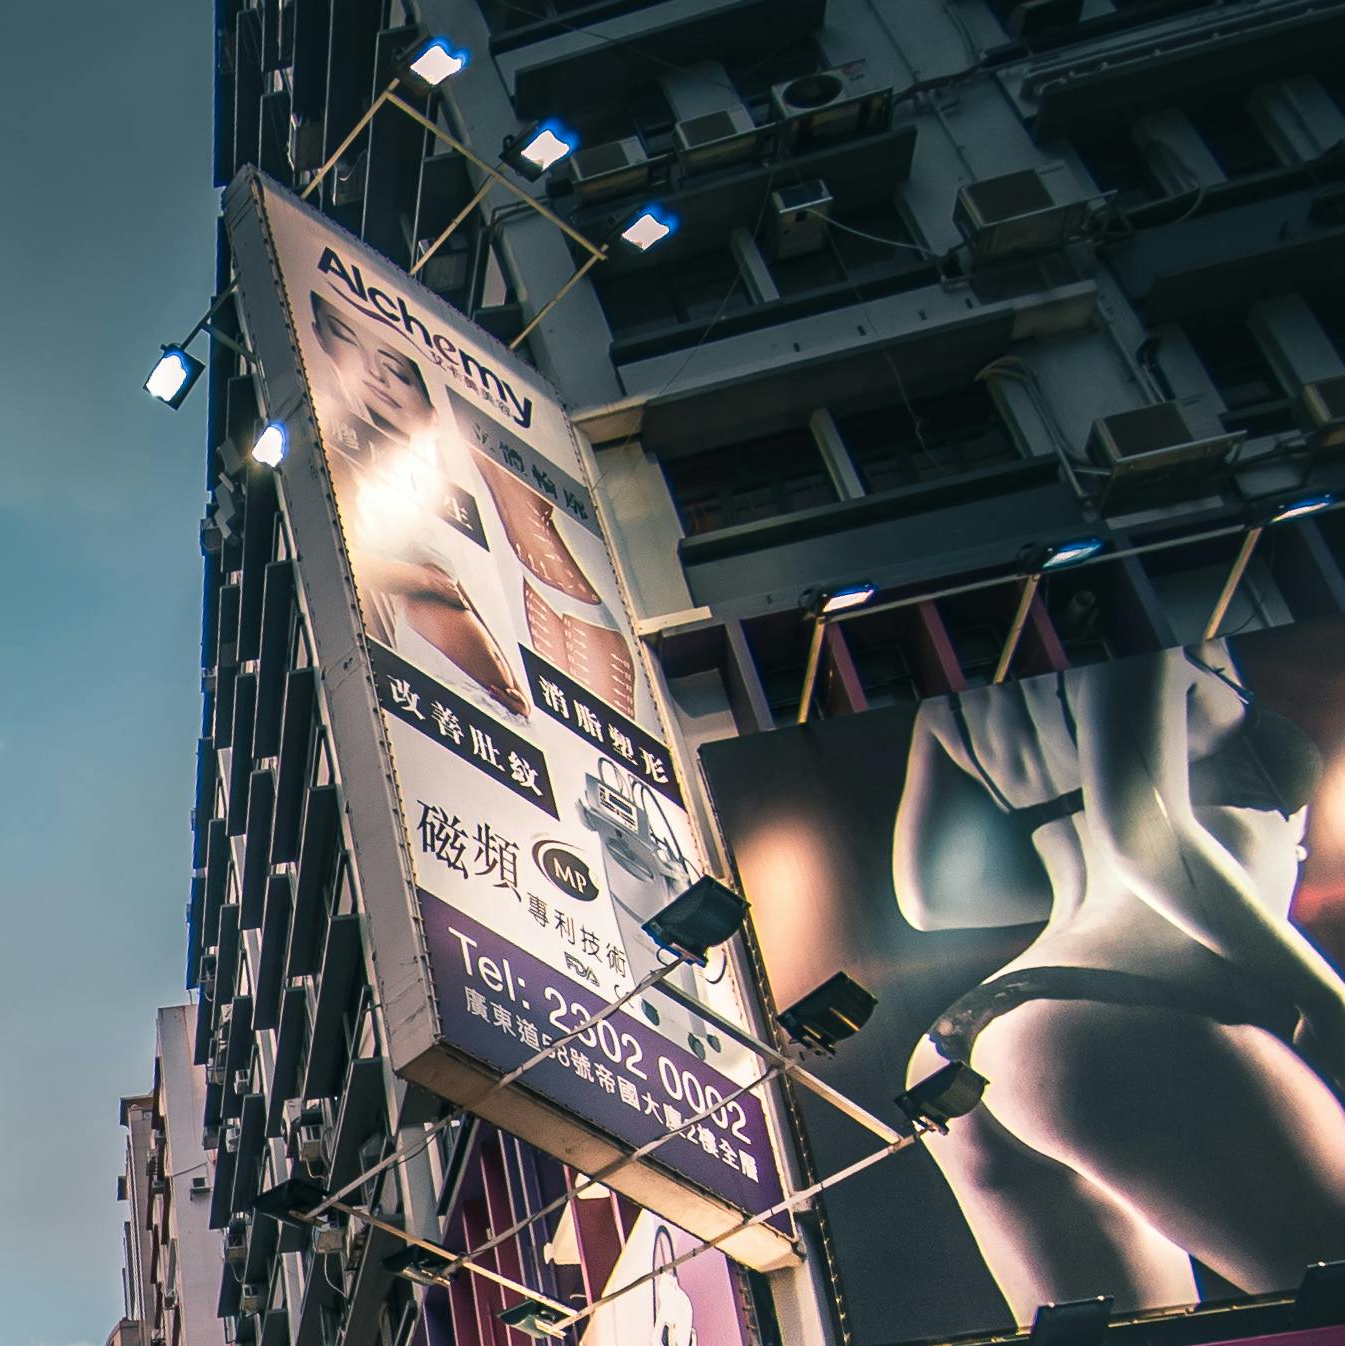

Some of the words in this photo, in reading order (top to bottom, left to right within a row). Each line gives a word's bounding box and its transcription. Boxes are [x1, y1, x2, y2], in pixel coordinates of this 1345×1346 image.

[318, 246, 532, 429] Alchemy
[387, 674, 543, 797] 改善肚紋
[538, 674, 669, 784] 消脂塑形
[416, 799, 522, 903] 磁頻
[553, 857, 588, 893] MP
[528, 891, 627, 978] 專利技術
[564, 951, 600, 987] FDA
[448, 926, 531, 1010] Tel:
[544, 985, 648, 1081] 2302
[658, 1055, 752, 1145] 0002
